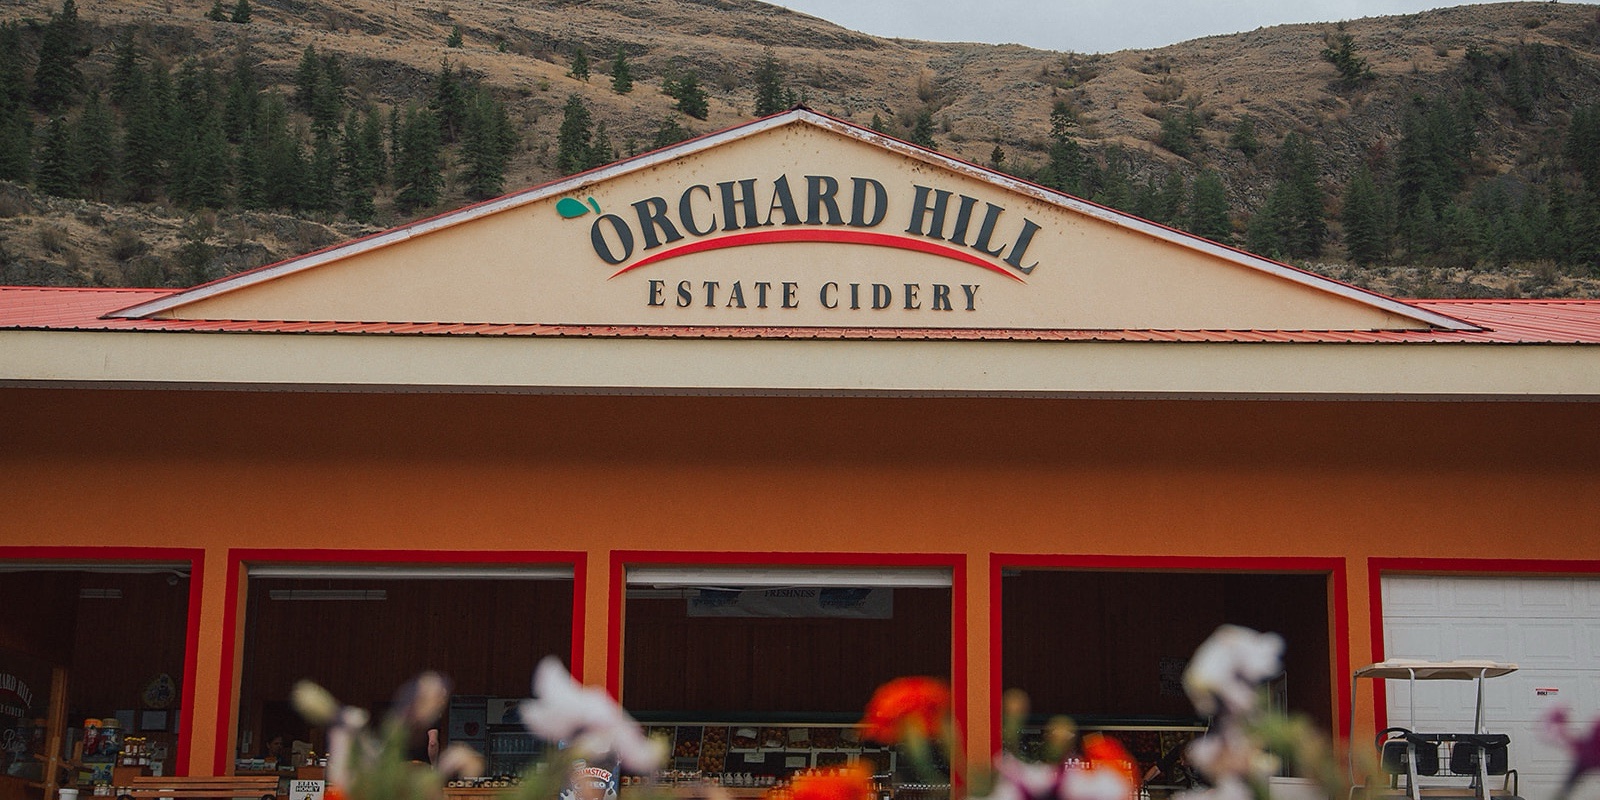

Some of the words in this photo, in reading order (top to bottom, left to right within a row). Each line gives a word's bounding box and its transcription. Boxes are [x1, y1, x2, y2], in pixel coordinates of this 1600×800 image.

[590, 173, 888, 264] ORCHARD
[904, 184, 1043, 275] HILL
[648, 279, 800, 309] ESTATE
[820, 281, 981, 311] CIDERY
[764, 588, 816, 598] FRESHNESS
